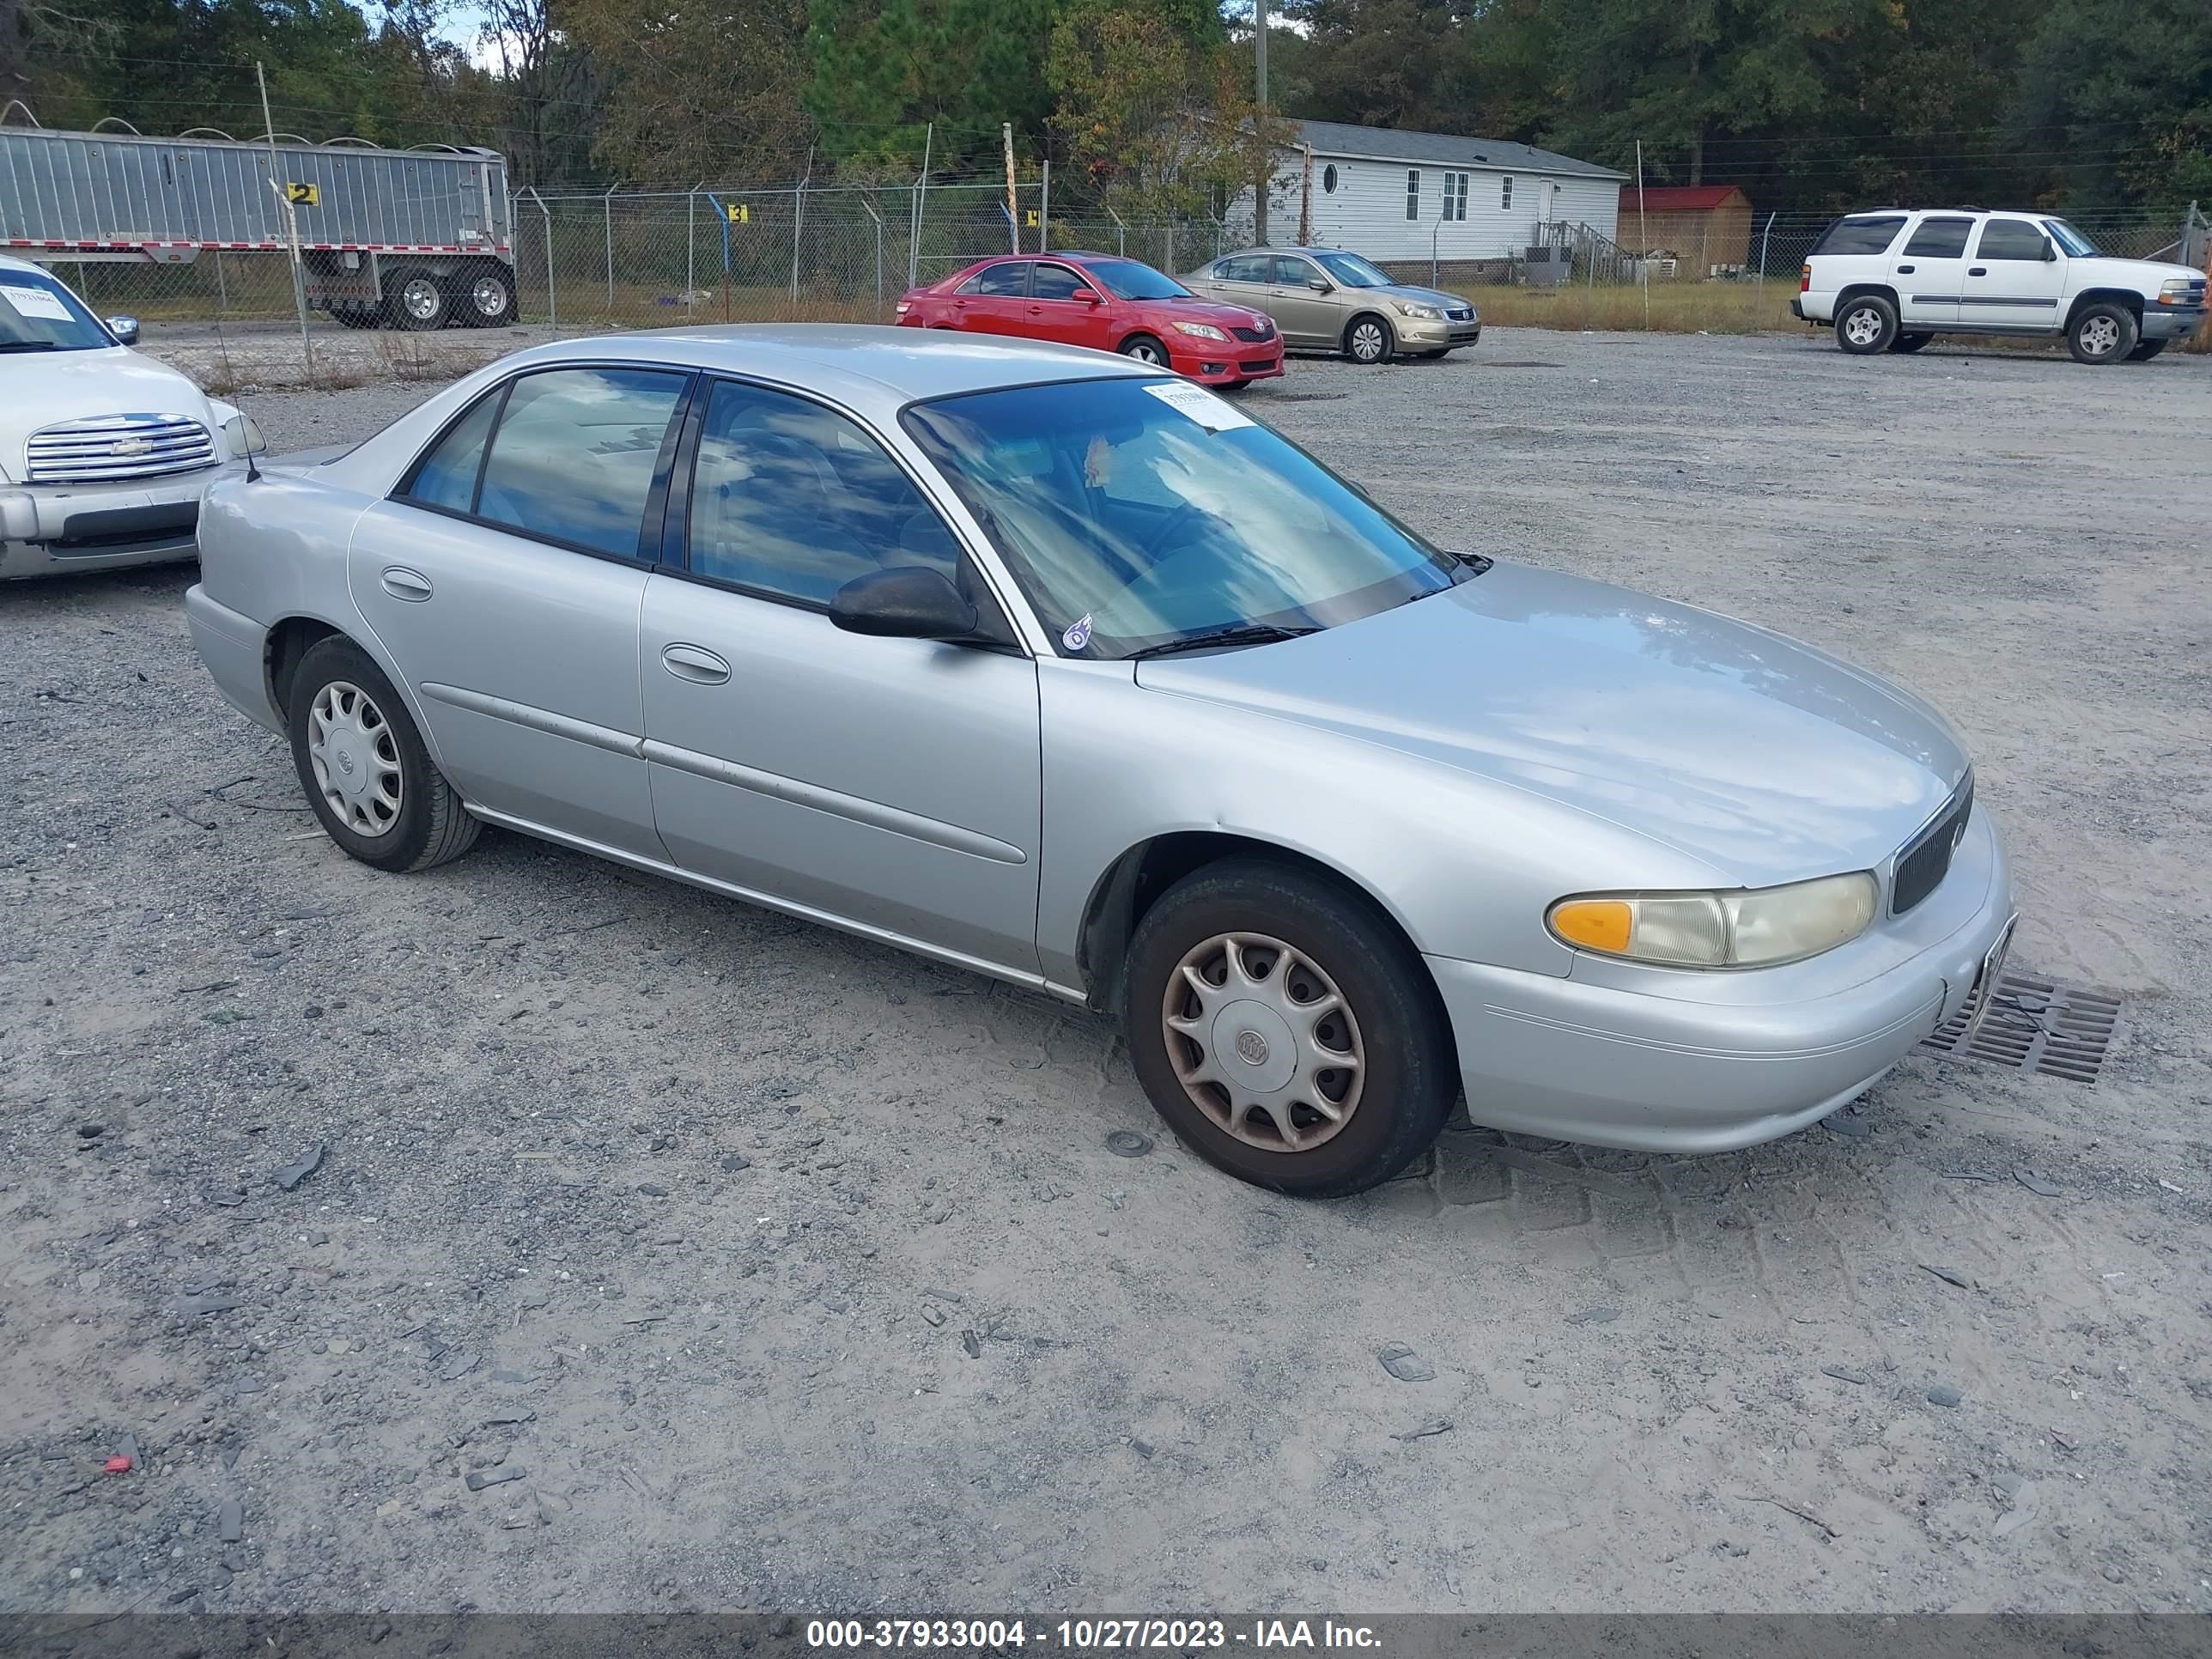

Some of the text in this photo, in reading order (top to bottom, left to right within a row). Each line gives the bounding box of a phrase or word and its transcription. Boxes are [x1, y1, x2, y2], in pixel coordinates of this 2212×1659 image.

[291, 184, 313, 205] 2
[732, 204, 741, 222] 3
[1031, 210, 1039, 227] 4
